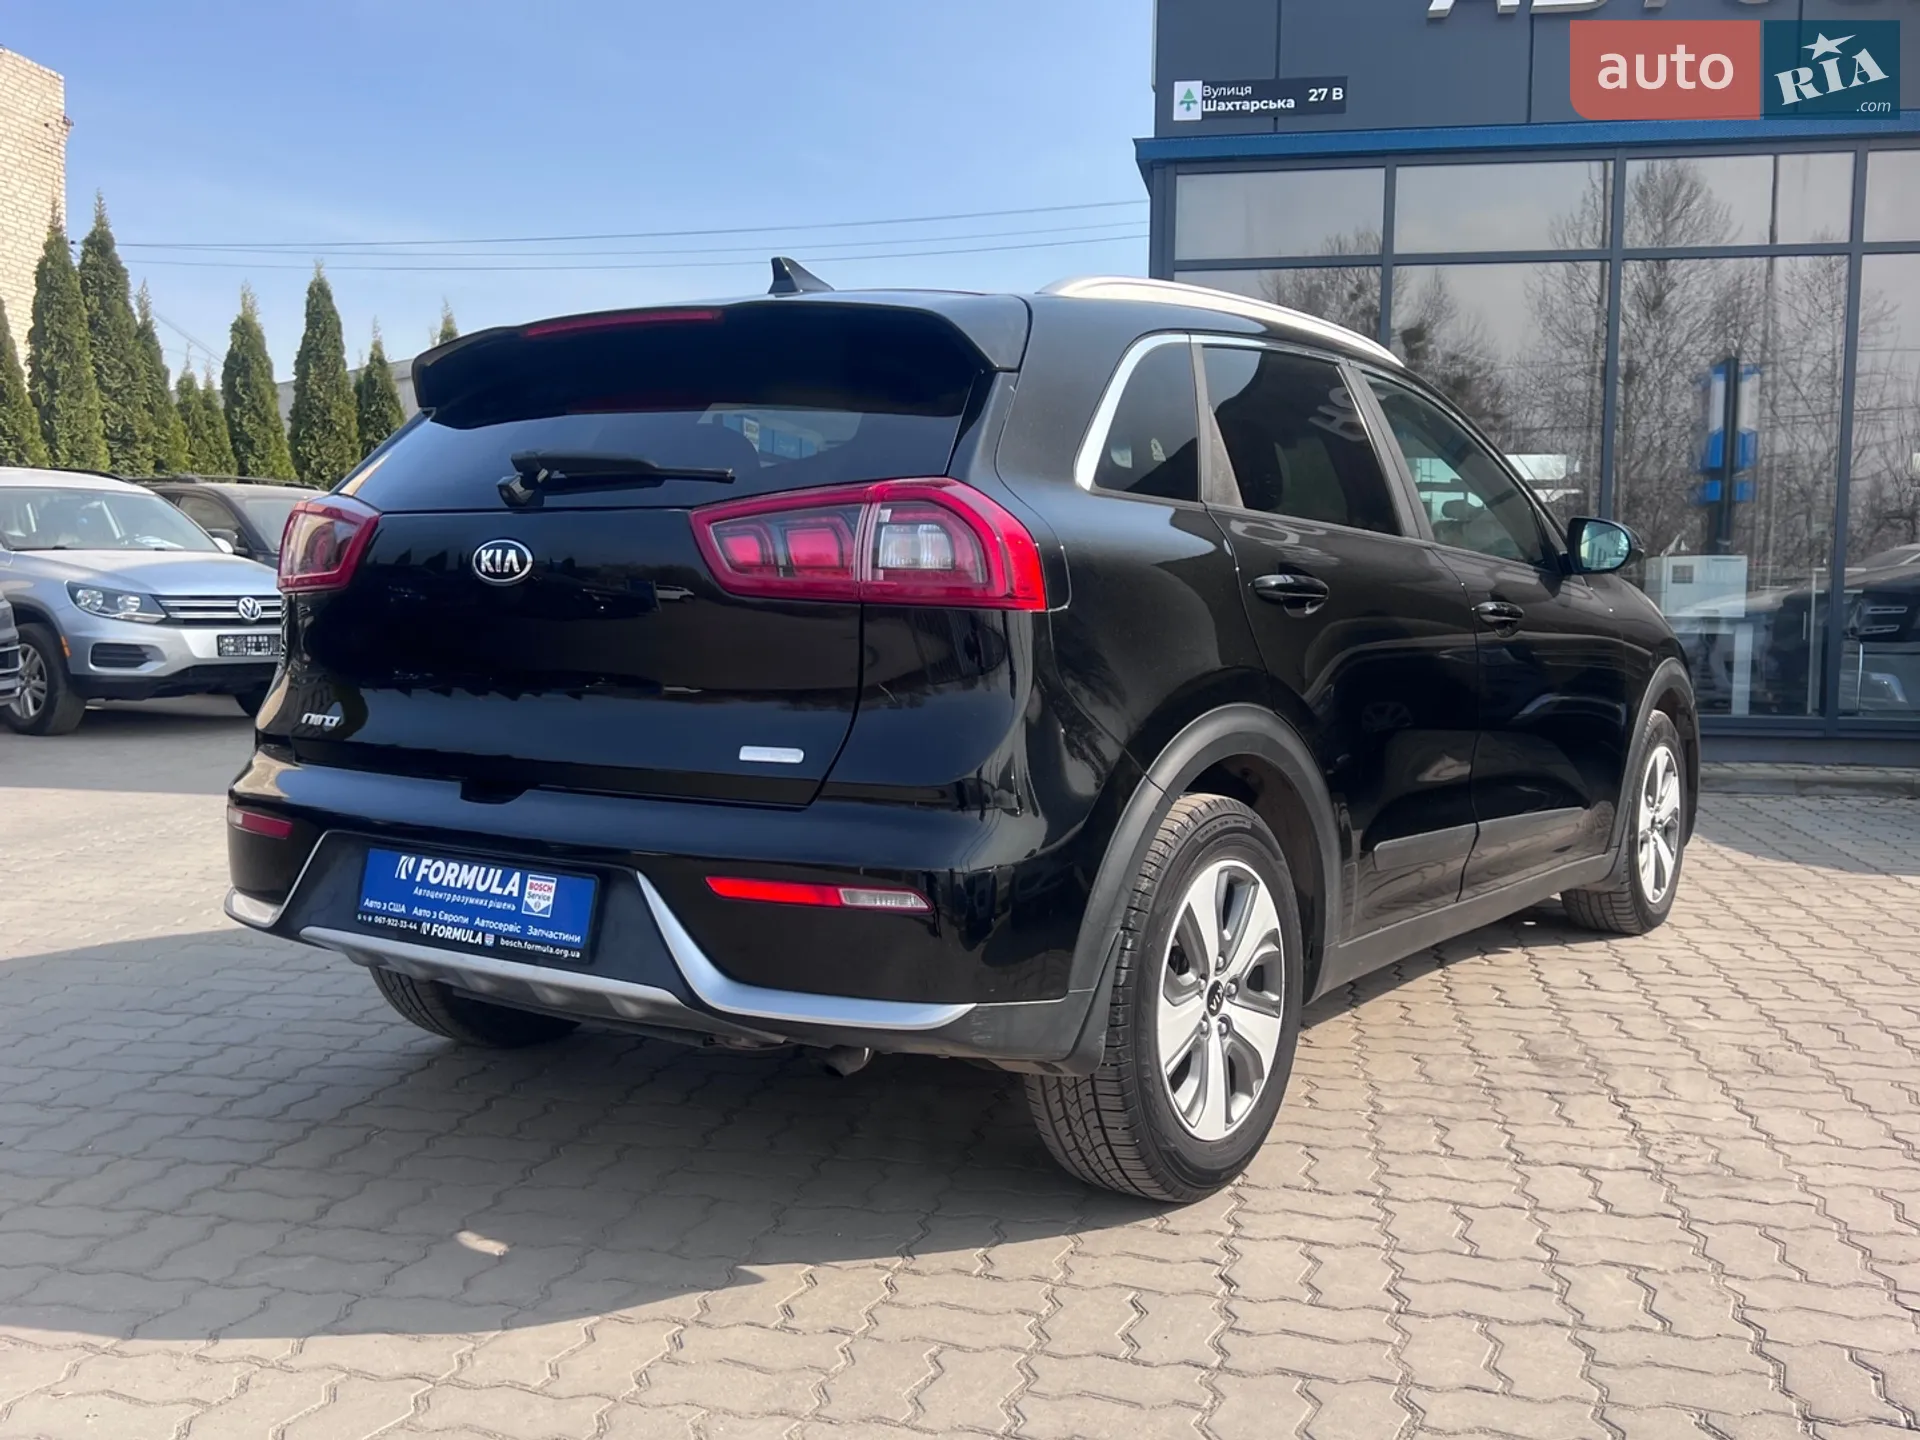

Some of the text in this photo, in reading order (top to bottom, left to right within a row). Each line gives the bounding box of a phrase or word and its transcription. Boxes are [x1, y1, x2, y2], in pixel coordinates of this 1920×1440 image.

[1202, 86, 1252, 98] Вулиця
[1308, 88, 1328, 102] 27
[1202, 98, 1295, 113] Шахтарська
[480, 549, 521, 573] KIA
[415, 858, 521, 897] FORMULA
[526, 891, 551, 902] Service
[528, 882, 553, 893] BOSCH
[413, 886, 516, 911] Автоцентр розумних рішень
[363, 898, 381, 910] Авто
[388, 901, 406, 913] США
[412, 906, 431, 918] Авто
[438, 910, 469, 924] Європи
[474, 917, 521, 933] Автосервіс
[526, 925, 581, 943] Запчастини
[374, 915, 417, 930] 067-922-33-44
[431, 923, 483, 945] FORMULA
[500, 937, 581, 958] bosch.formula.org.ua
